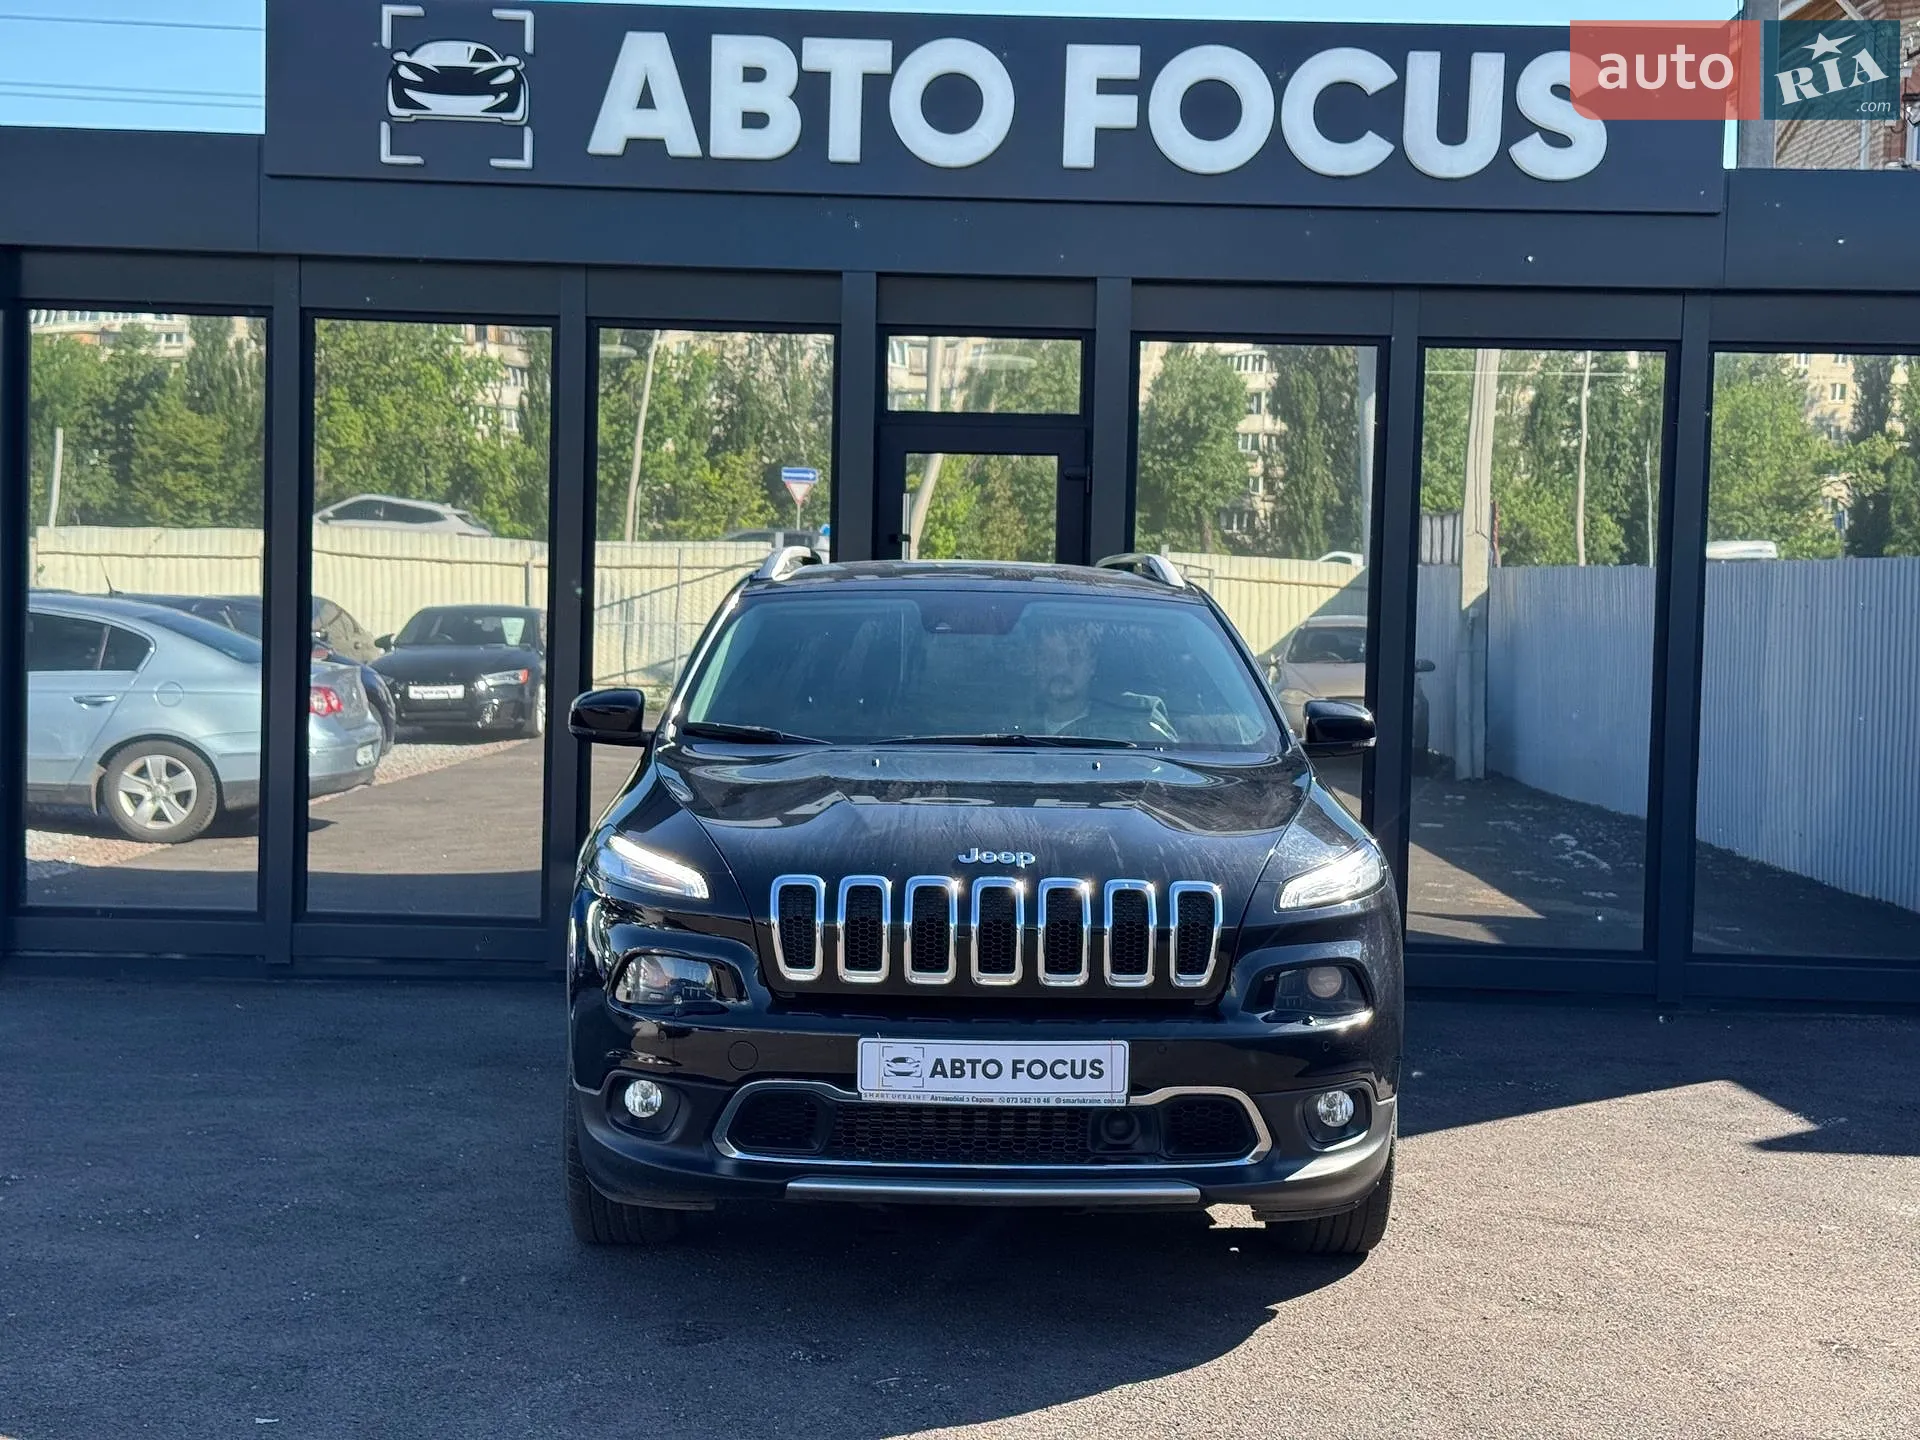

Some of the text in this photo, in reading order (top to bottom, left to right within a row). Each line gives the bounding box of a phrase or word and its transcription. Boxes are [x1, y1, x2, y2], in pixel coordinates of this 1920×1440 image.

[587, 31, 1608, 182] АВТО FOCUS
[958, 847, 1036, 869] Jeep
[929, 1057, 1105, 1081] АВТО FOCUS
